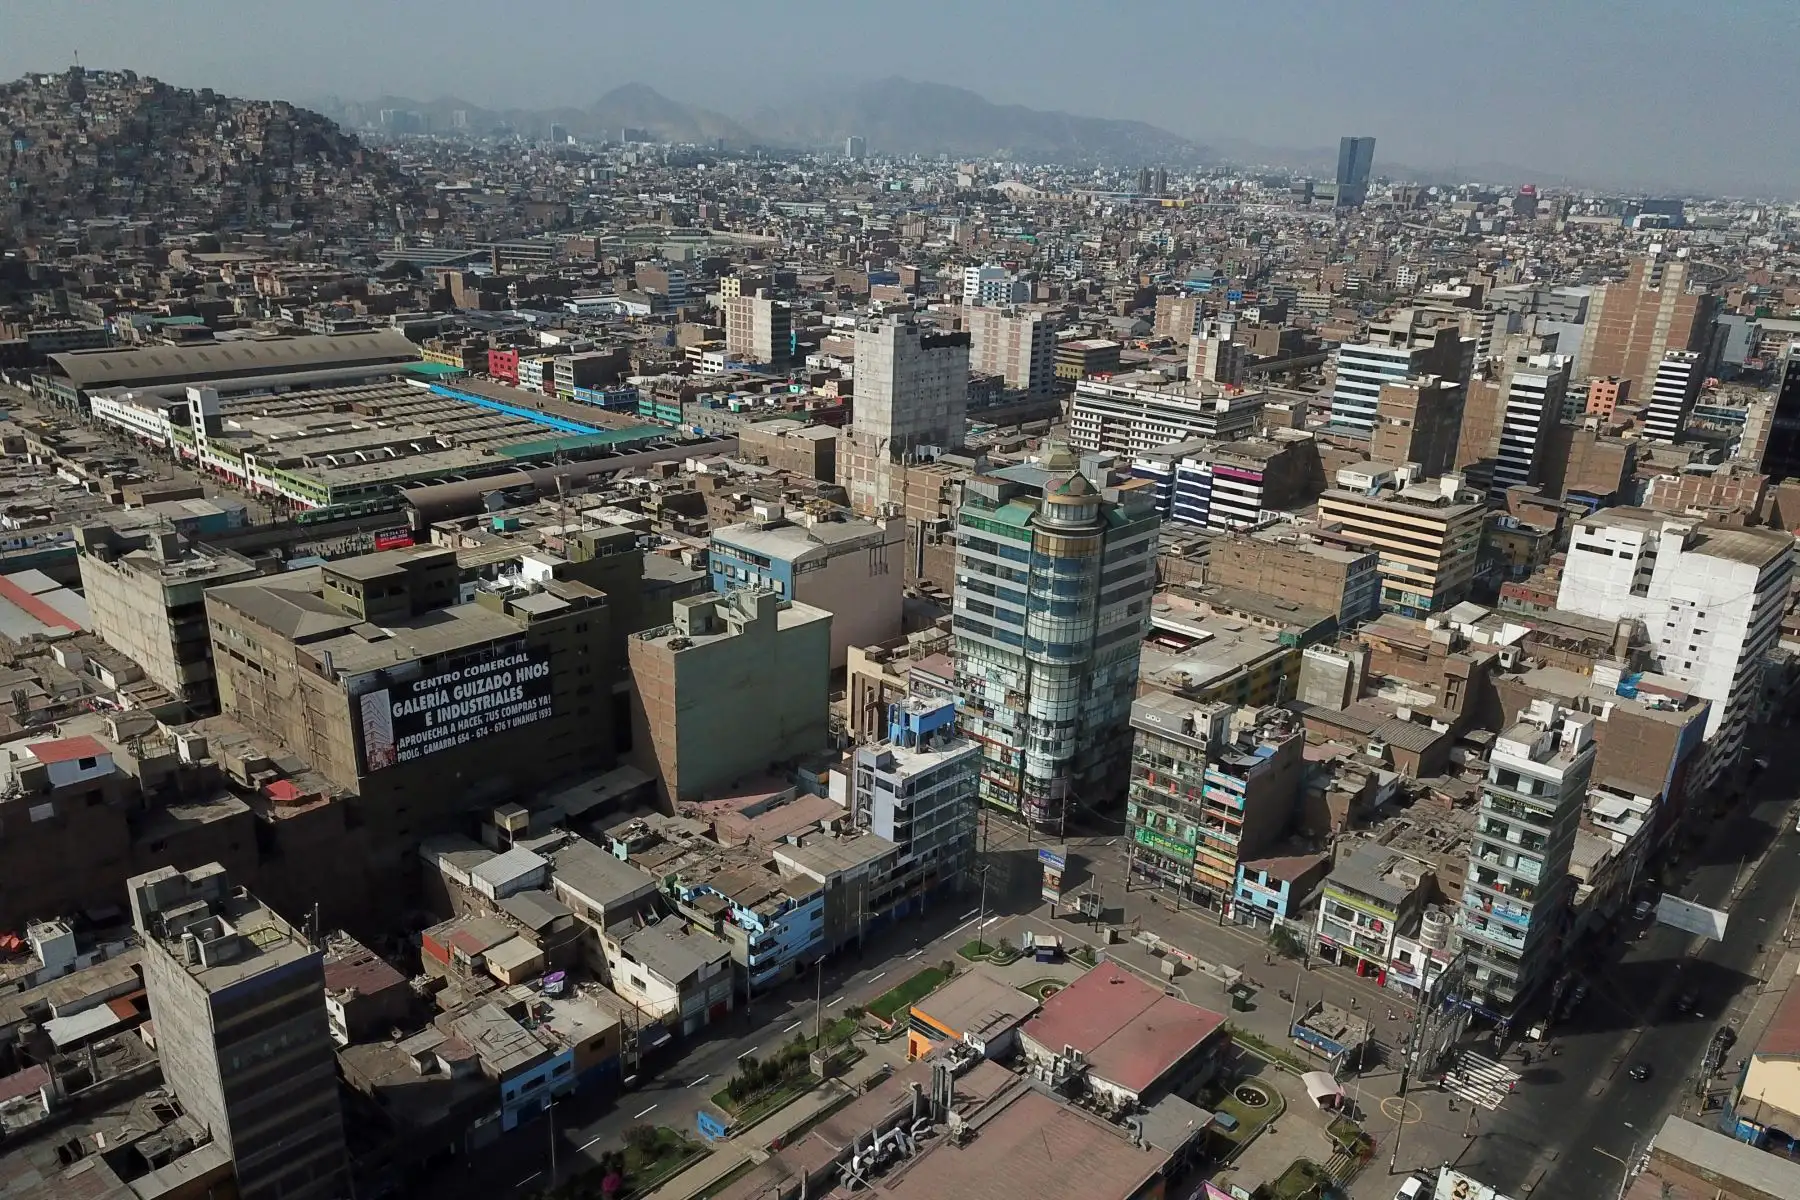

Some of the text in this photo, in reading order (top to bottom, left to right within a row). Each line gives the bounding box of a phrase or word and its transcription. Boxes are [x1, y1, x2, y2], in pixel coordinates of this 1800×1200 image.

[393, 661, 549, 717] GALERÍA GUIZADO HNOS
[413, 653, 529, 692] CENTRO COMERCIAL
[425, 685, 523, 726] E INDUSTRIALES
[451, 723, 456, 734] A
[458, 714, 482, 731] HACER
[485, 712, 499, 723] TUS
[502, 701, 536, 719] COMPRAS
[539, 694, 551, 708] YA!
[424, 737, 456, 754] GAMARRA
[458, 734, 469, 744] 654
[477, 728, 488, 738] 674
[495, 722, 506, 733] 676
[507, 720, 511, 728] Y
[540, 708, 551, 720] 1593
